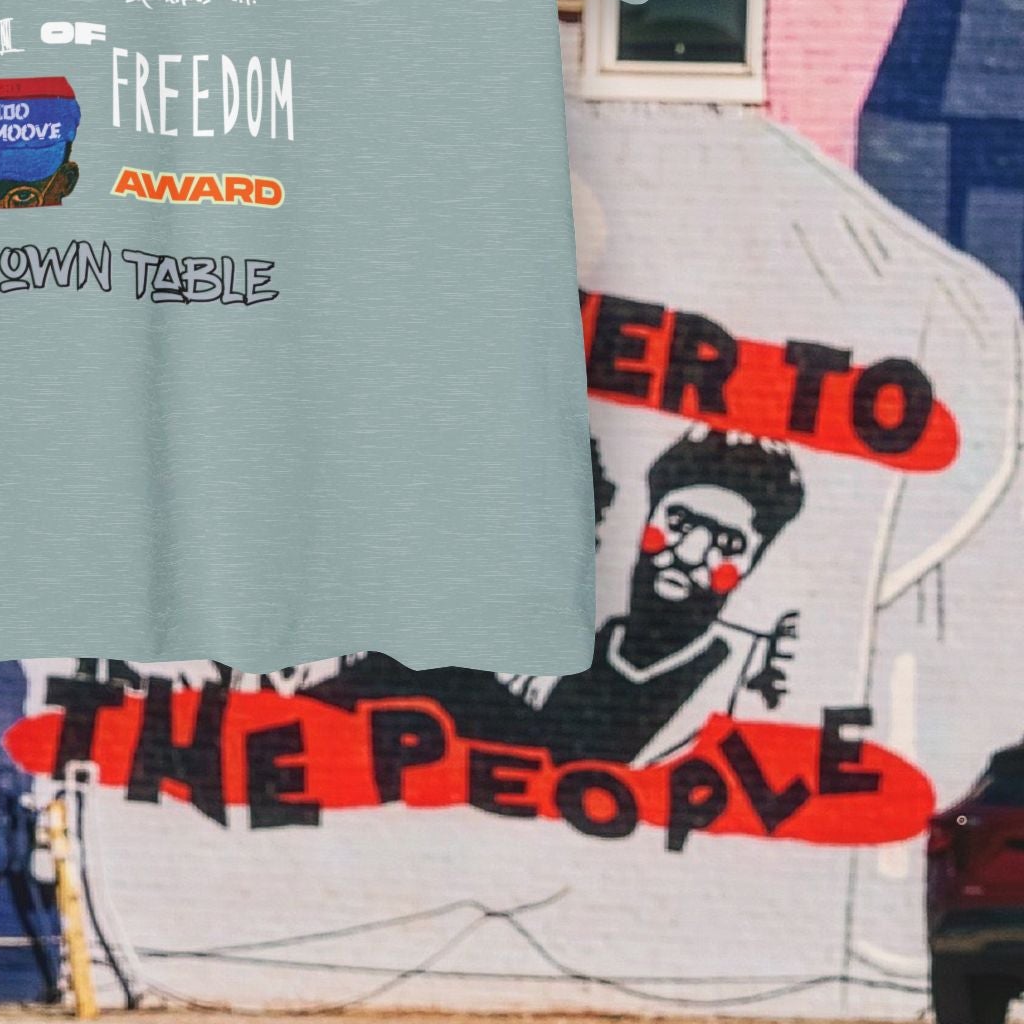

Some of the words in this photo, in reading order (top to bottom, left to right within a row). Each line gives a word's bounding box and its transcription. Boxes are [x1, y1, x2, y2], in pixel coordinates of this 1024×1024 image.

[40, 21, 107, 45] OF
[112, 47, 295, 141] FREEDOM
[110, 165, 286, 208] AWARD
[0, 240, 111, 293] OWN
[122, 249, 279, 305] TABLE
[787, 340, 934, 455] TO
[46, 673, 321, 830] THE
[372, 706, 881, 853] PEOPLE
